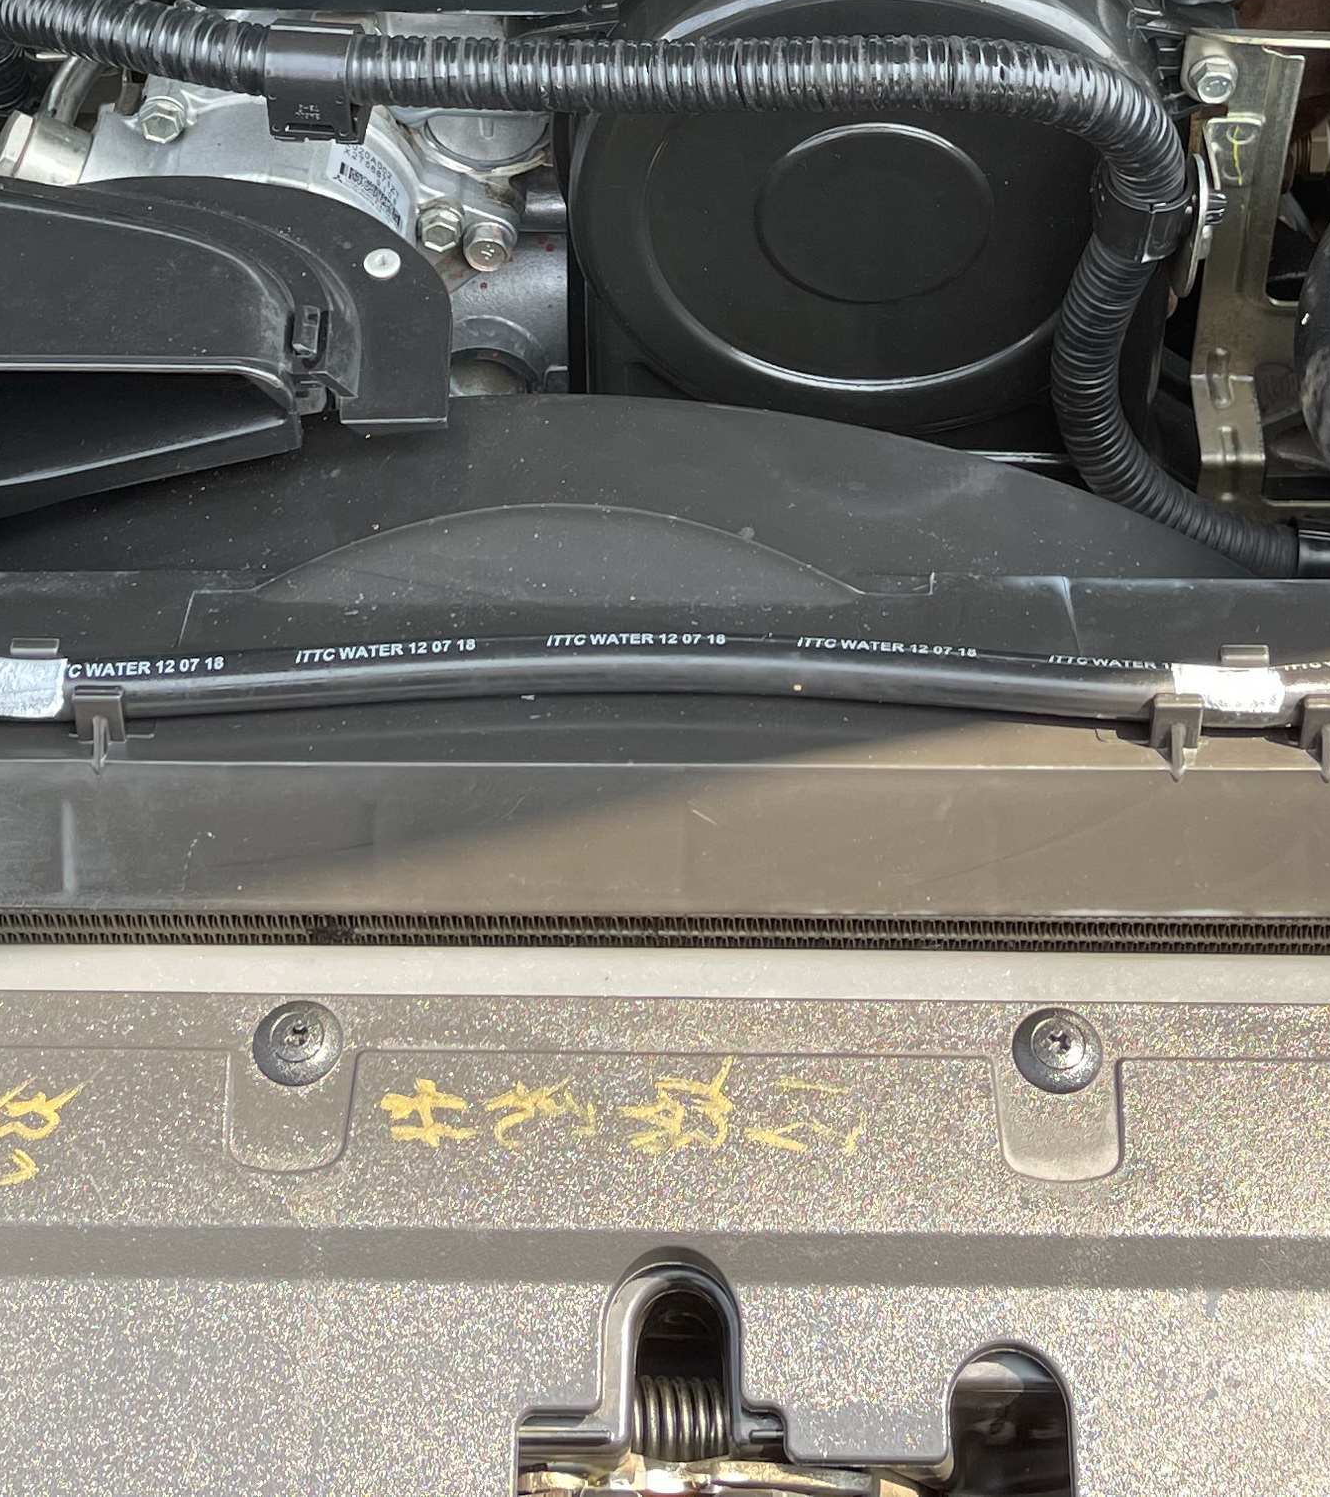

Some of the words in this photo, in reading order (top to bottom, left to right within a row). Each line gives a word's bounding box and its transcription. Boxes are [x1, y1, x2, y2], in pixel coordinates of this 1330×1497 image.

[590, 633, 654, 645] WATER
[659, 634, 678, 644] 12
[682, 634, 702, 645] 07
[707, 634, 726, 645] 18
[840, 639, 905, 652] WATER
[910, 644, 928, 654] 12
[933, 645, 952, 655] 07
[958, 647, 977, 658] 18
[339, 643, 404, 661] WATER
[408, 642, 427, 654] 12
[432, 640, 452, 653] 07
[456, 638, 476, 651] 18
[86, 661, 151, 677] WATER
[155, 659, 175, 673] 12
[179, 657, 200, 672] 07
[205, 656, 224, 670] 18
[1092, 657, 1157, 670] WATER
